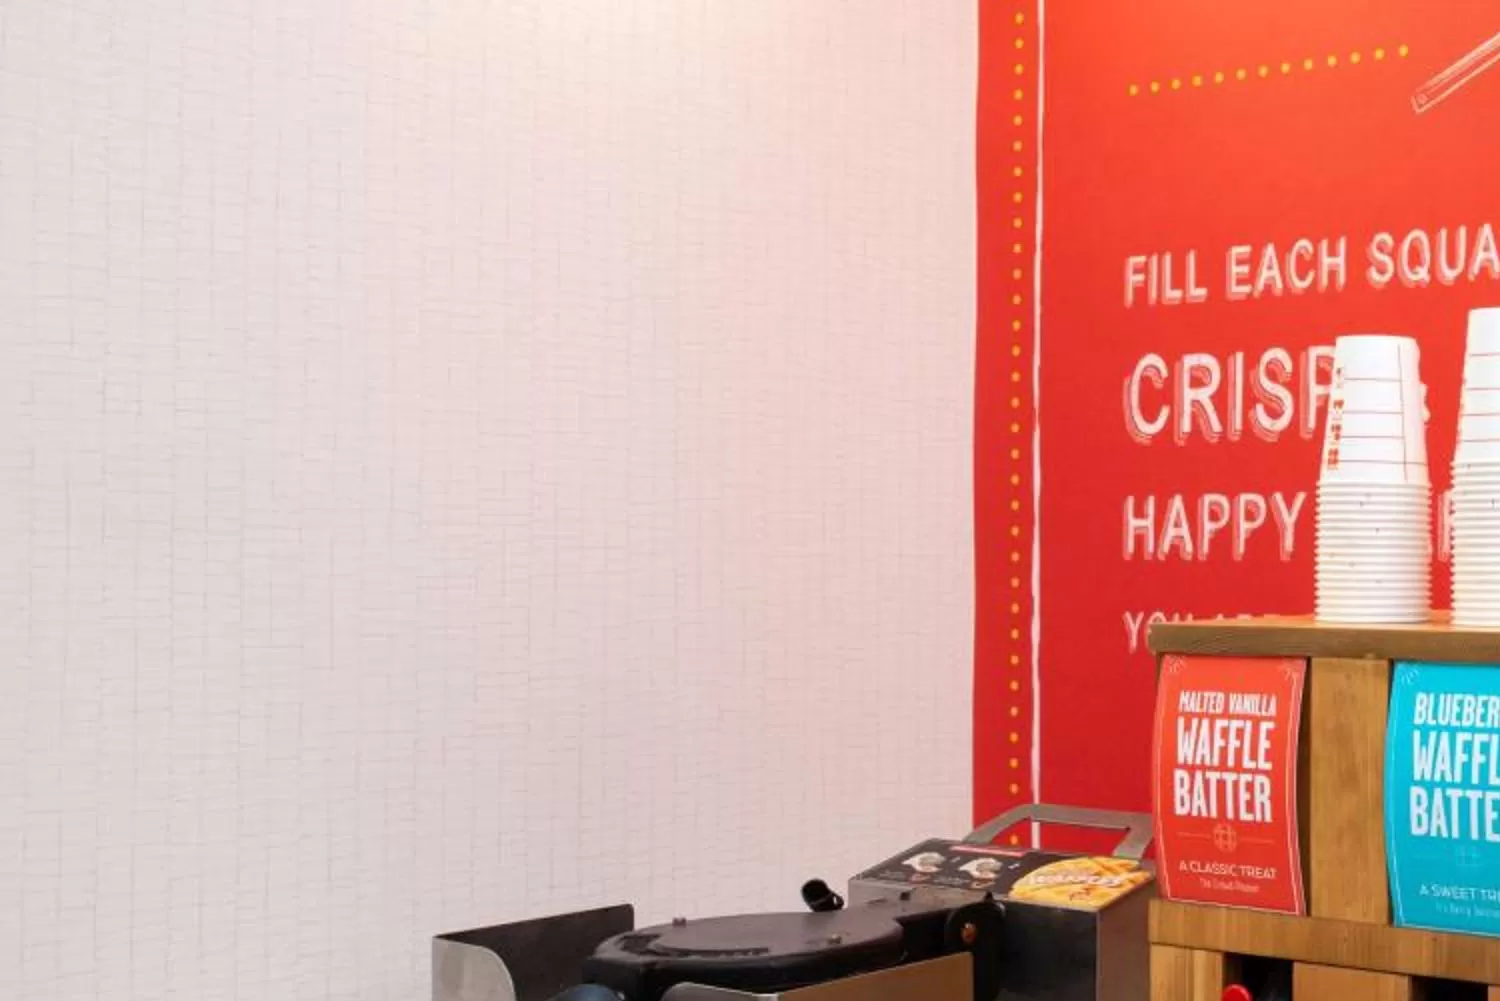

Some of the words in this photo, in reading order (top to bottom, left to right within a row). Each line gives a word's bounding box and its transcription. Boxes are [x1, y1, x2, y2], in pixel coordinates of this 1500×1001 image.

[1124, 249, 1208, 308] FILL
[1225, 237, 1348, 300] EACH
[1122, 491, 1307, 561] HAPPY
[1179, 689, 1225, 714] MALTED
[1229, 692, 1277, 717] VANILLA
[1177, 715, 1276, 771] WAFFLE
[1173, 768, 1273, 823] BATTER
[1189, 860, 1239, 877] CLASSIC
[1239, 864, 1277, 880] TREAT
[1431, 883, 1479, 900] SWEET
